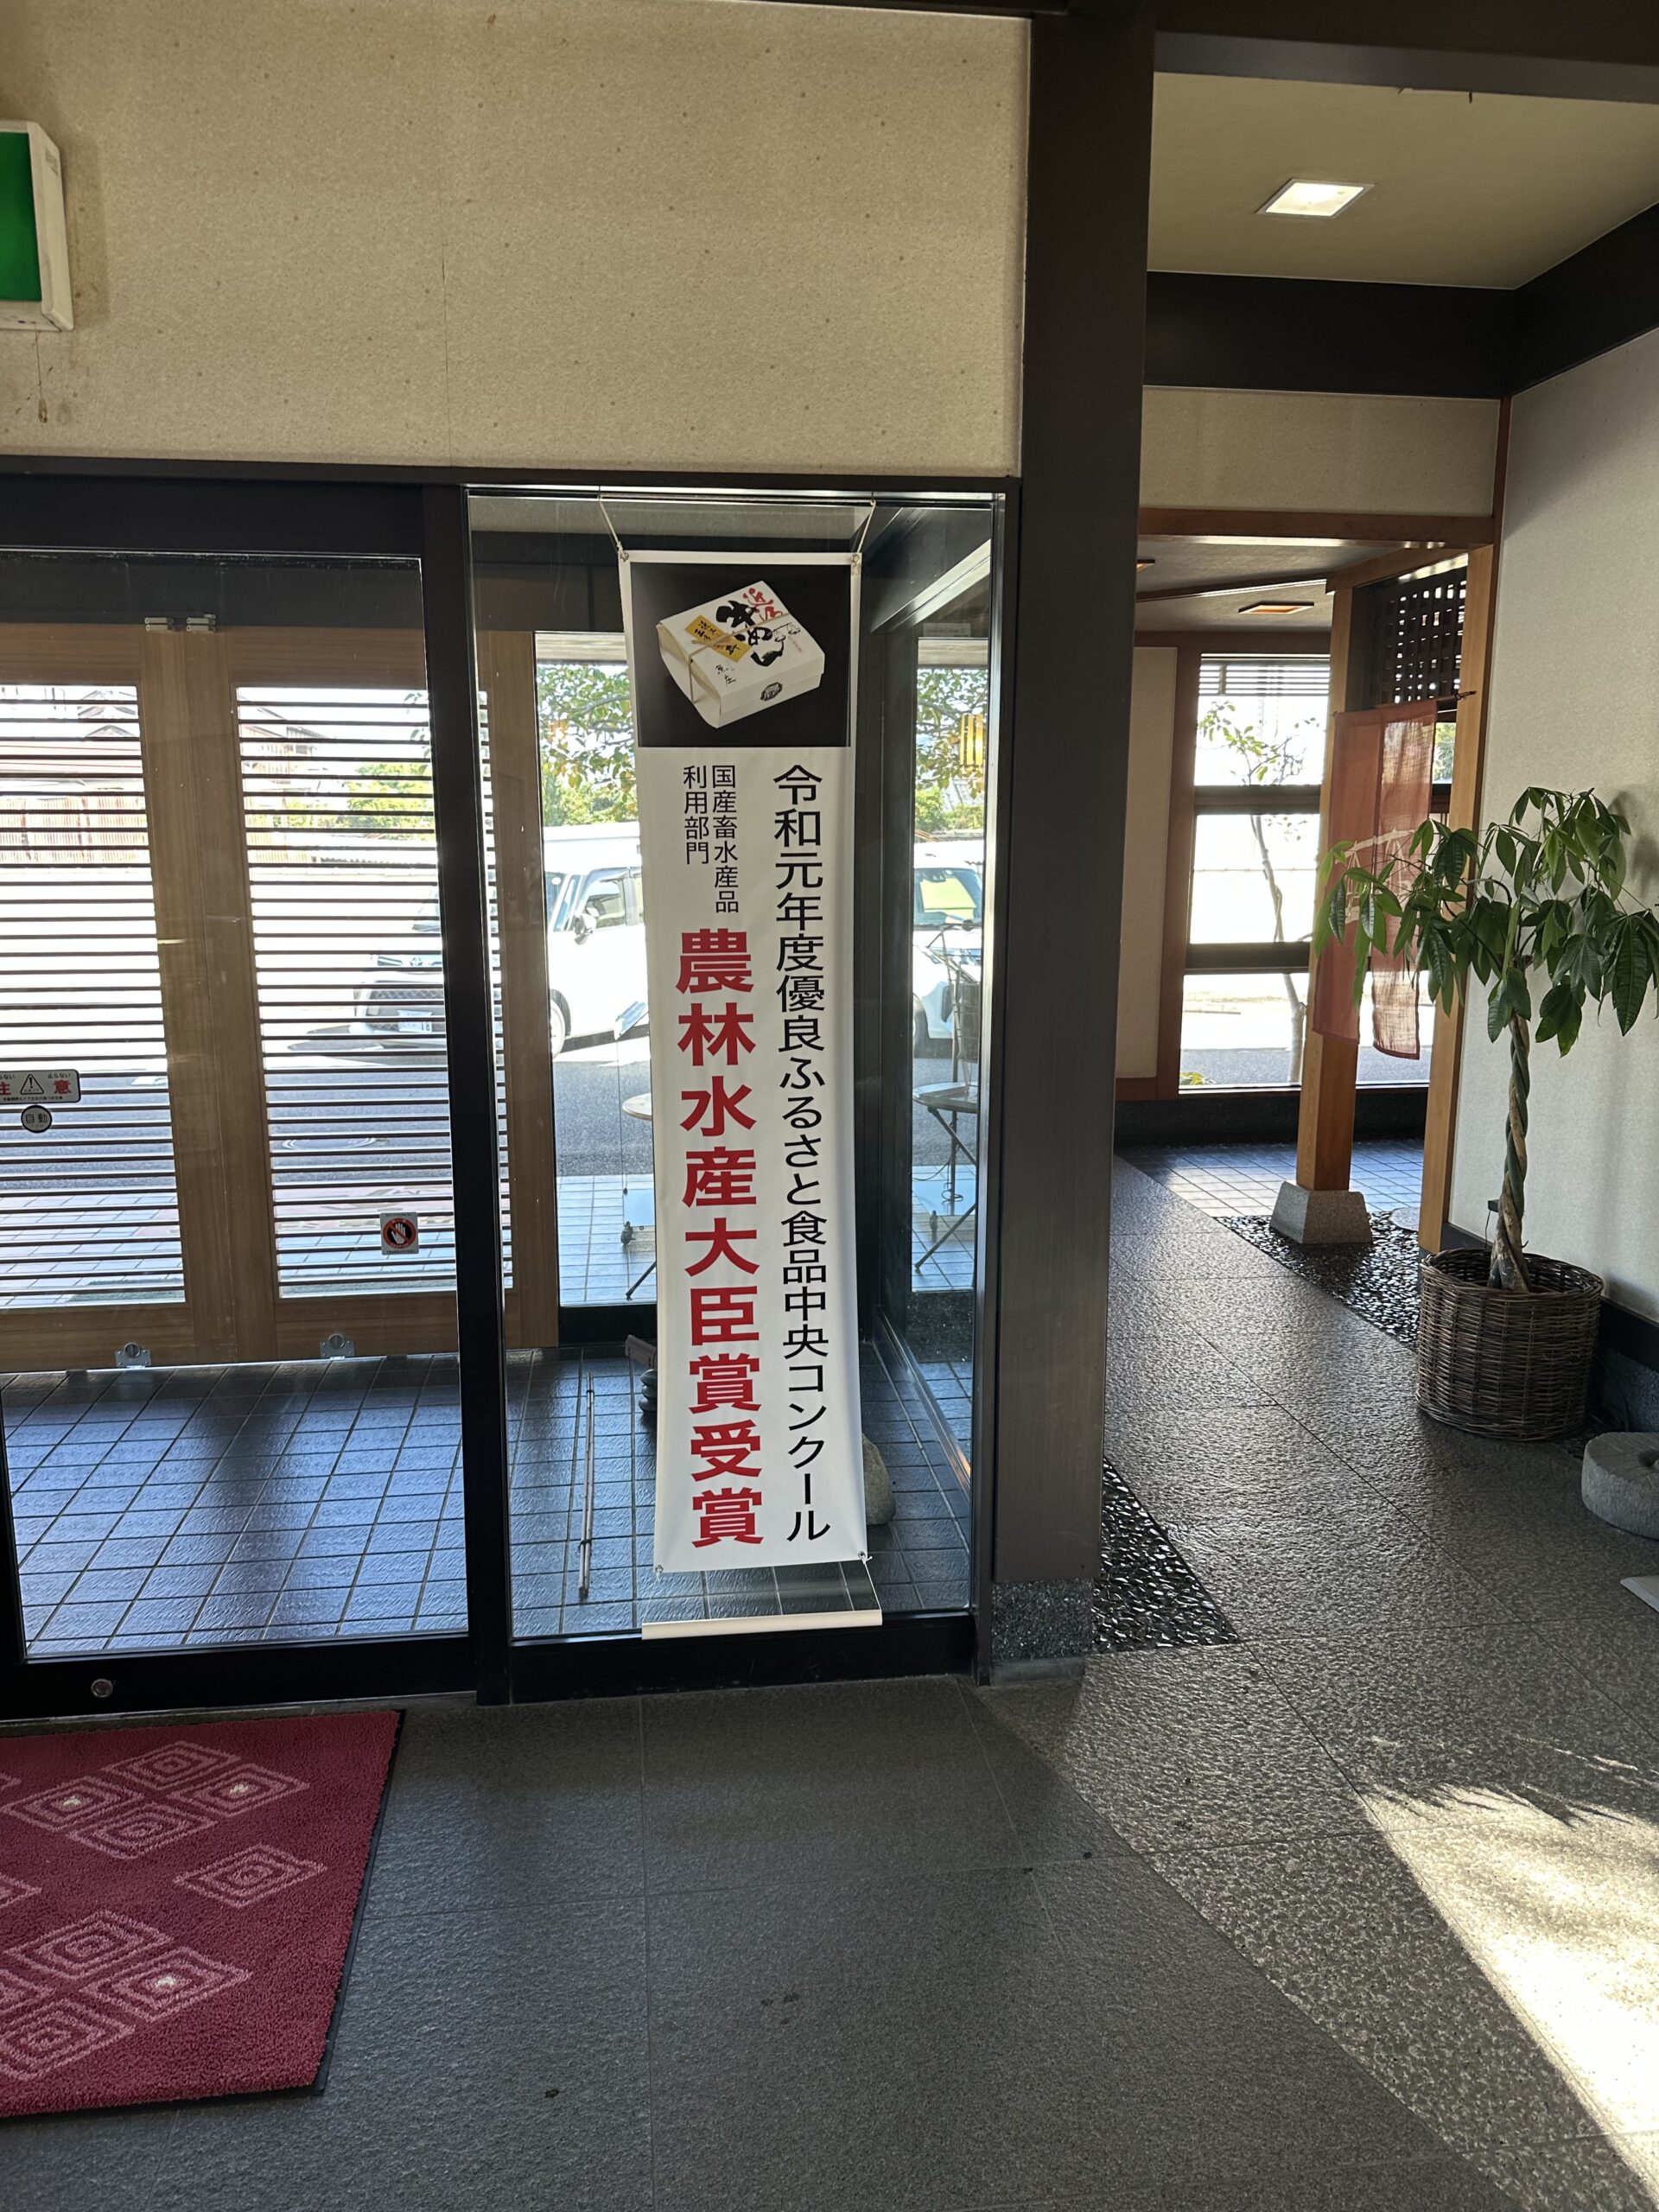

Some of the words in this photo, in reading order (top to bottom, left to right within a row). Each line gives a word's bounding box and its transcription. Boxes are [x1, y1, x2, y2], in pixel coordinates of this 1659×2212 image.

[683, 765, 709, 865] 利用部門
[711, 765, 739, 913] 国産畜水産品
[677, 928, 762, 1548] 農林水産大臣賞受賞
[773, 764, 830, 1542] 令和元年度優良ふるさと食品中央コンクール
